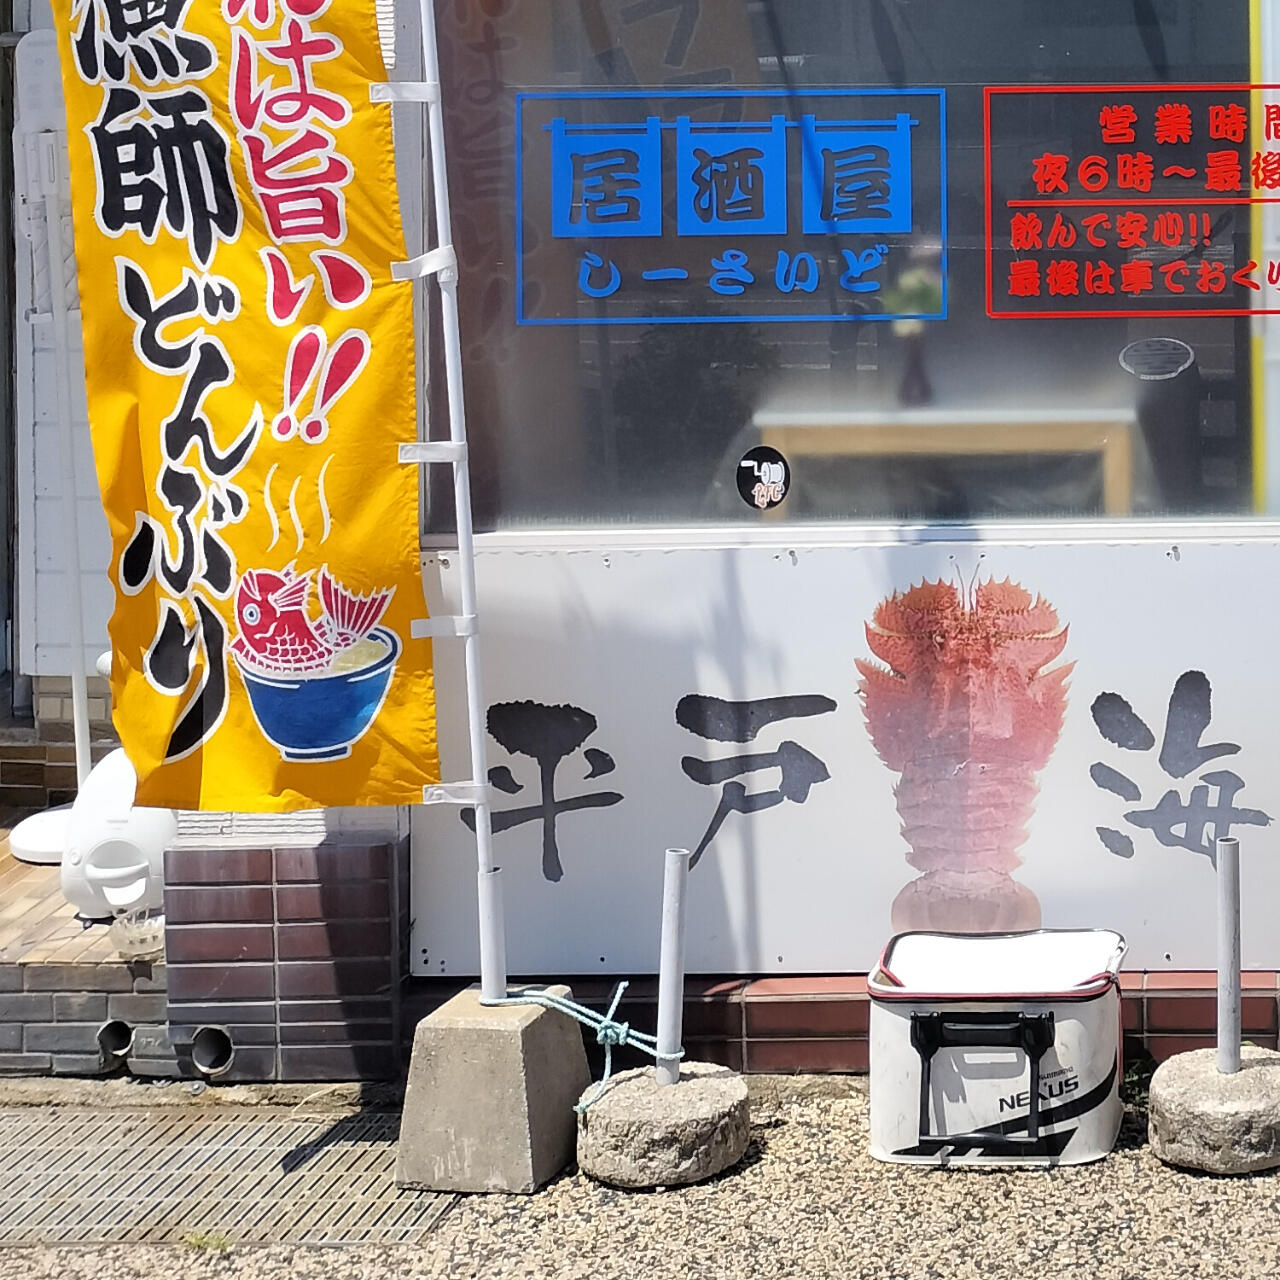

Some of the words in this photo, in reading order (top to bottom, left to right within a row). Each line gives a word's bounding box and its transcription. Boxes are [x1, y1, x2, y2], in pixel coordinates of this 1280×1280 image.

[568, 144, 892, 224] 居酒屋
[578, 243, 889, 298] しーさいど
[461, 691, 838, 883] 平戸
